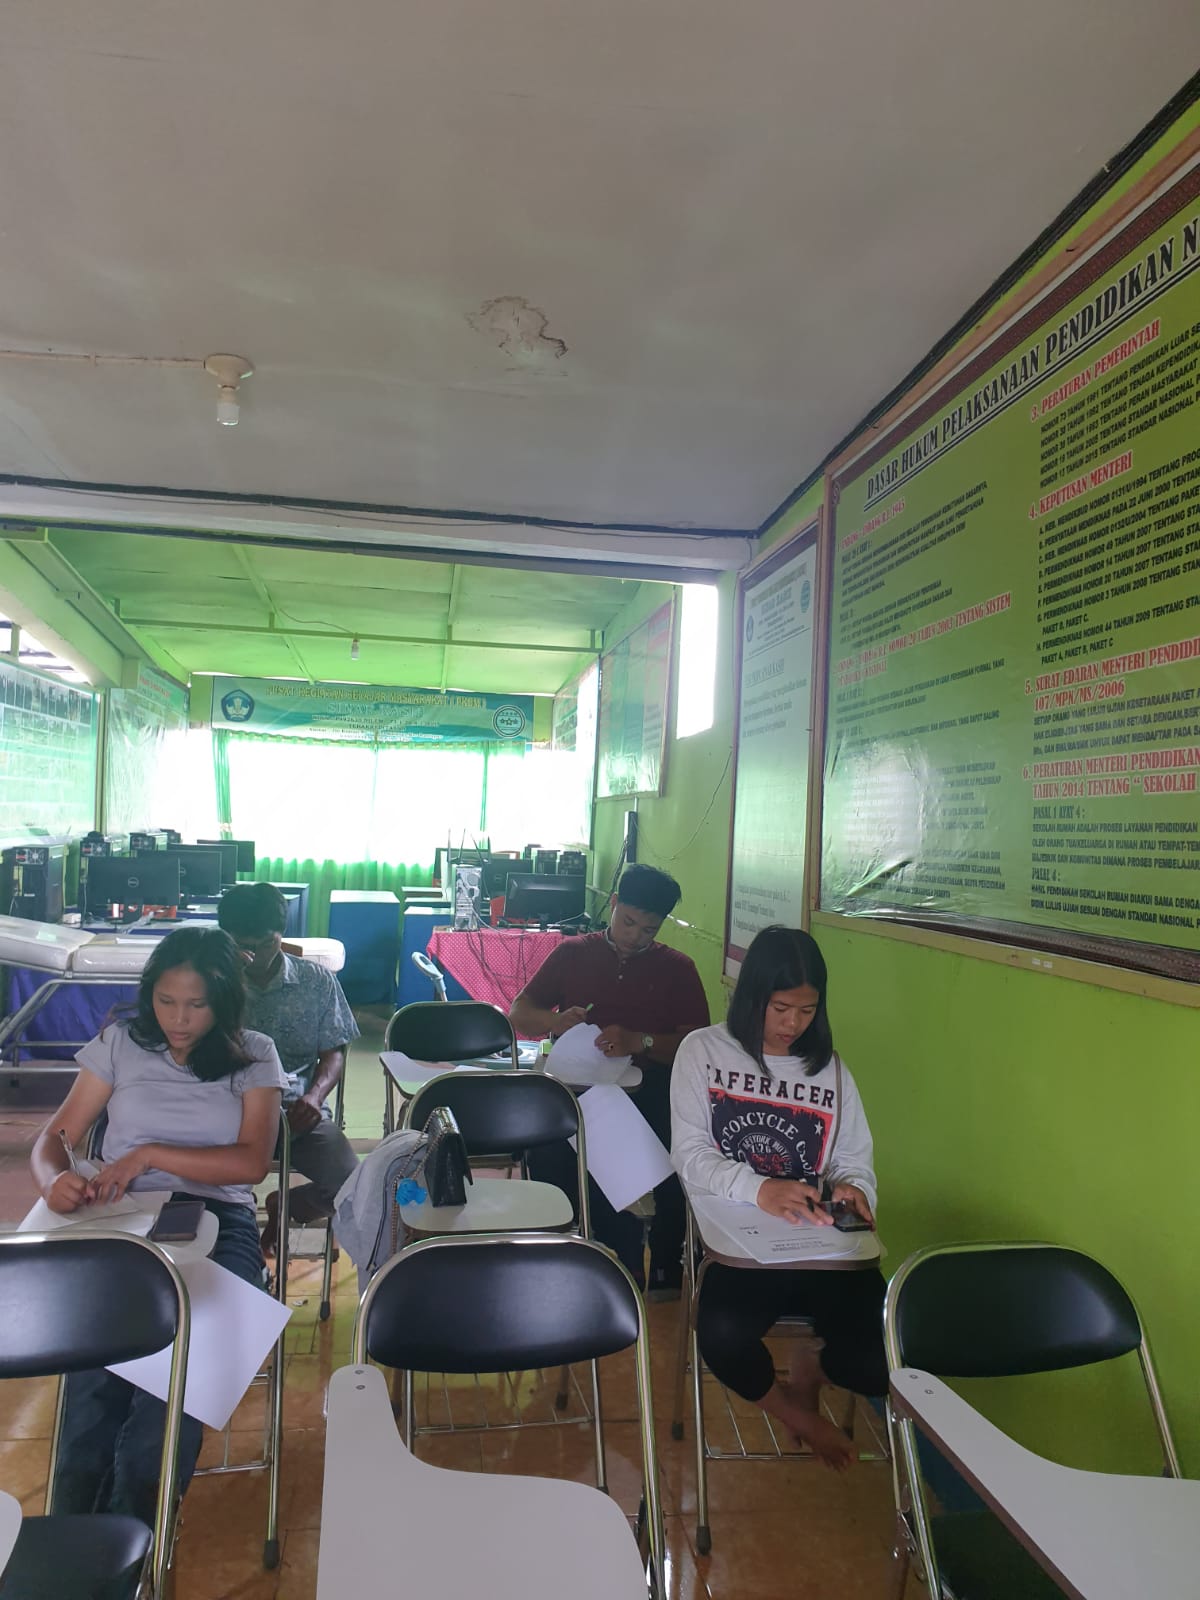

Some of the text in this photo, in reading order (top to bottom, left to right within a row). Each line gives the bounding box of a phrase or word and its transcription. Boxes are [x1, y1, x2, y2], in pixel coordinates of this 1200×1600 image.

[867, 456, 896, 500] DASAR
[901, 423, 937, 475] HUKUM
[942, 342, 1038, 444] PELAKSANAAN
[1045, 238, 1168, 366] PENDIDIKAN
[1031, 318, 1159, 421] 3. PERATURAN PEMERINTAH
[1100, 369, 1128, 396] TENTANG
[1129, 342, 1168, 377] PENDIDIKAN
[1170, 328, 1189, 350] LUAR
[1099, 356, 1197, 426] TENTANG PERAN MASYARAKAT
[1100, 367, 1154, 410] TENTANG TENAGA
[1099, 376, 1193, 440] TENTANG STANDAR NASIONAL
[1099, 431, 1126, 456] TENTANG
[1127, 414, 1156, 439] STANDAR
[1158, 393, 1193, 422] NASIONAL
[1029, 450, 1131, 519] 4. KEPUTUSAN MENTERI
[1089, 457, 1180, 510] NOMOR TENTANG
[1088, 493, 1178, 542] NOMOR TENTANG
[1112, 500, 1127, 516] PADA
[1114, 530, 1135, 547] TAHUN
[1136, 522, 1152, 538] 2007
[1153, 508, 1185, 531] TENTANG
[1083, 527, 1184, 575] NOMOR 14 TAHUN 2007 TENTANG
[1112, 563, 1133, 580] TAHUN
[1134, 557, 1149, 573] 2007
[1151, 545, 1183, 567] TENTANG
[1083, 590, 1104, 607] NOMOR
[1105, 588, 1109, 599] 3
[1110, 581, 1131, 597] TAHUN
[1132, 575, 1147, 590] 2008
[1149, 563, 1181, 584] TENTANG
[955, 603, 983, 627] TENTANG
[985, 591, 1010, 616] SISTEM
[1065, 614, 1082, 628] PAKET
[1083, 598, 1183, 638] NOMOR 44 TAHUN 2009 TENTANG
[1041, 638, 1107, 664] PAKET PAKET PAKET
[1025, 650, 1145, 694] 5. SURAT EDARAN MENTERI
[1035, 679, 1124, 711] 107/MPN/MS/2006
[1171, 688, 1194, 702] PAKET
[1111, 725, 1191, 745] DAPAT MENDAFTAR PADA
[1126, 713, 1151, 726] SETARA
[1023, 746, 1200, 779] 6. PERATURAN MENTERI PENDIDIKAN
[1033, 772, 1195, 798] TAHUN 2014 TENTANG SEKOLAH
[1032, 823, 1055, 832] SEKOLAH
[1076, 823, 1098, 832] ADALAH
[1100, 823, 1122, 832] PROSES
[1124, 822, 1153, 832] LAYANAN
[1154, 822, 1197, 832] PENDIDIKAN
[1033, 806, 1051, 819] PASAL
[1032, 838, 1045, 846] OLEH
[1046, 838, 1064, 847] ORANG
[1107, 839, 1114, 848] DI
[1115, 839, 1137, 849] RUMAH
[1138, 839, 1156, 850] ATAU
[1102, 855, 1125, 866] DIMANA
[1126, 856, 1152, 867] PROSES
[1045, 900, 1194, 927] LULUS UJIAN SESUAI DENGAN STANDAR NASIONAL
[1046, 885, 1078, 897] PENDIDIKAN
[1079, 888, 1105, 900] SEKOLAH
[1106, 890, 1128, 902] RUMAH
[1130, 892, 1152, 904] DIAKUI
[1154, 894, 1173, 907] SAMA
